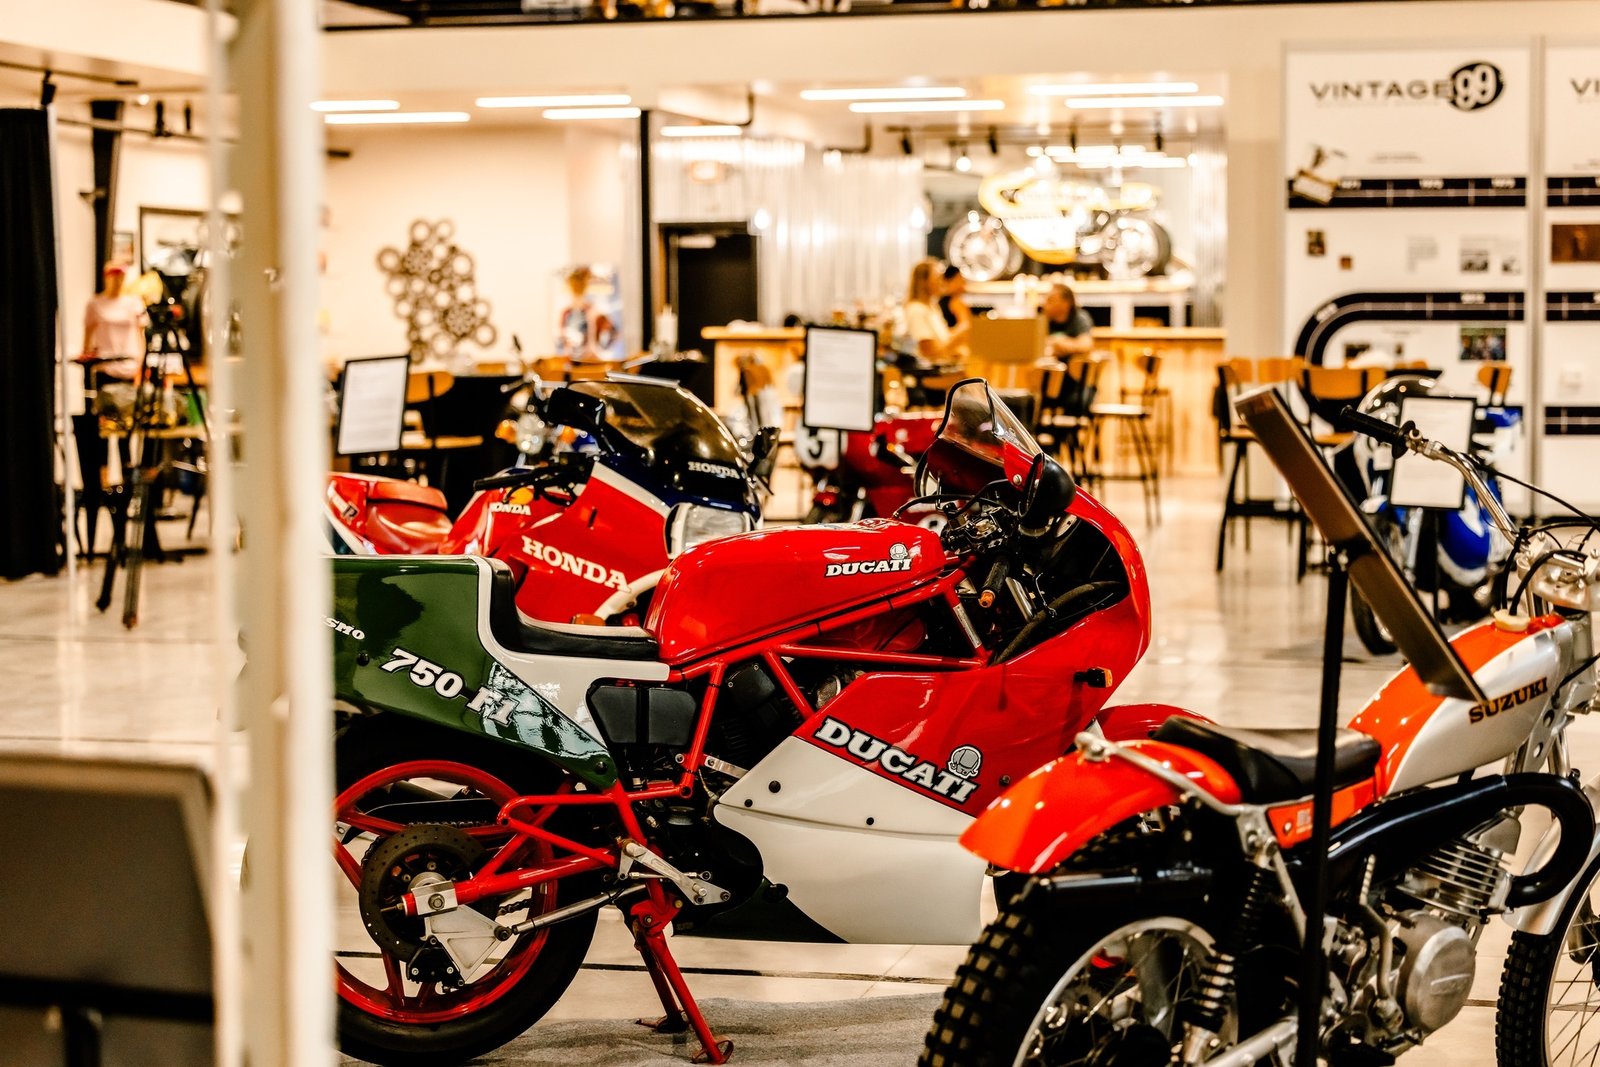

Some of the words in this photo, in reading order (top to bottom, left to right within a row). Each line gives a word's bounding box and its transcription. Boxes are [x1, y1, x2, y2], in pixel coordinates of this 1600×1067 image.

[1309, 79, 1453, 101] VINTAGE
[687, 461, 740, 480] HONDA
[521, 535, 632, 594] HONDA
[825, 557, 912, 577] DUCATI
[320, 614, 366, 640] SMO
[379, 648, 465, 699] 750
[466, 686, 520, 727] F1
[1469, 677, 1548, 725] SUZUKI
[814, 715, 980, 804] DUCATI
